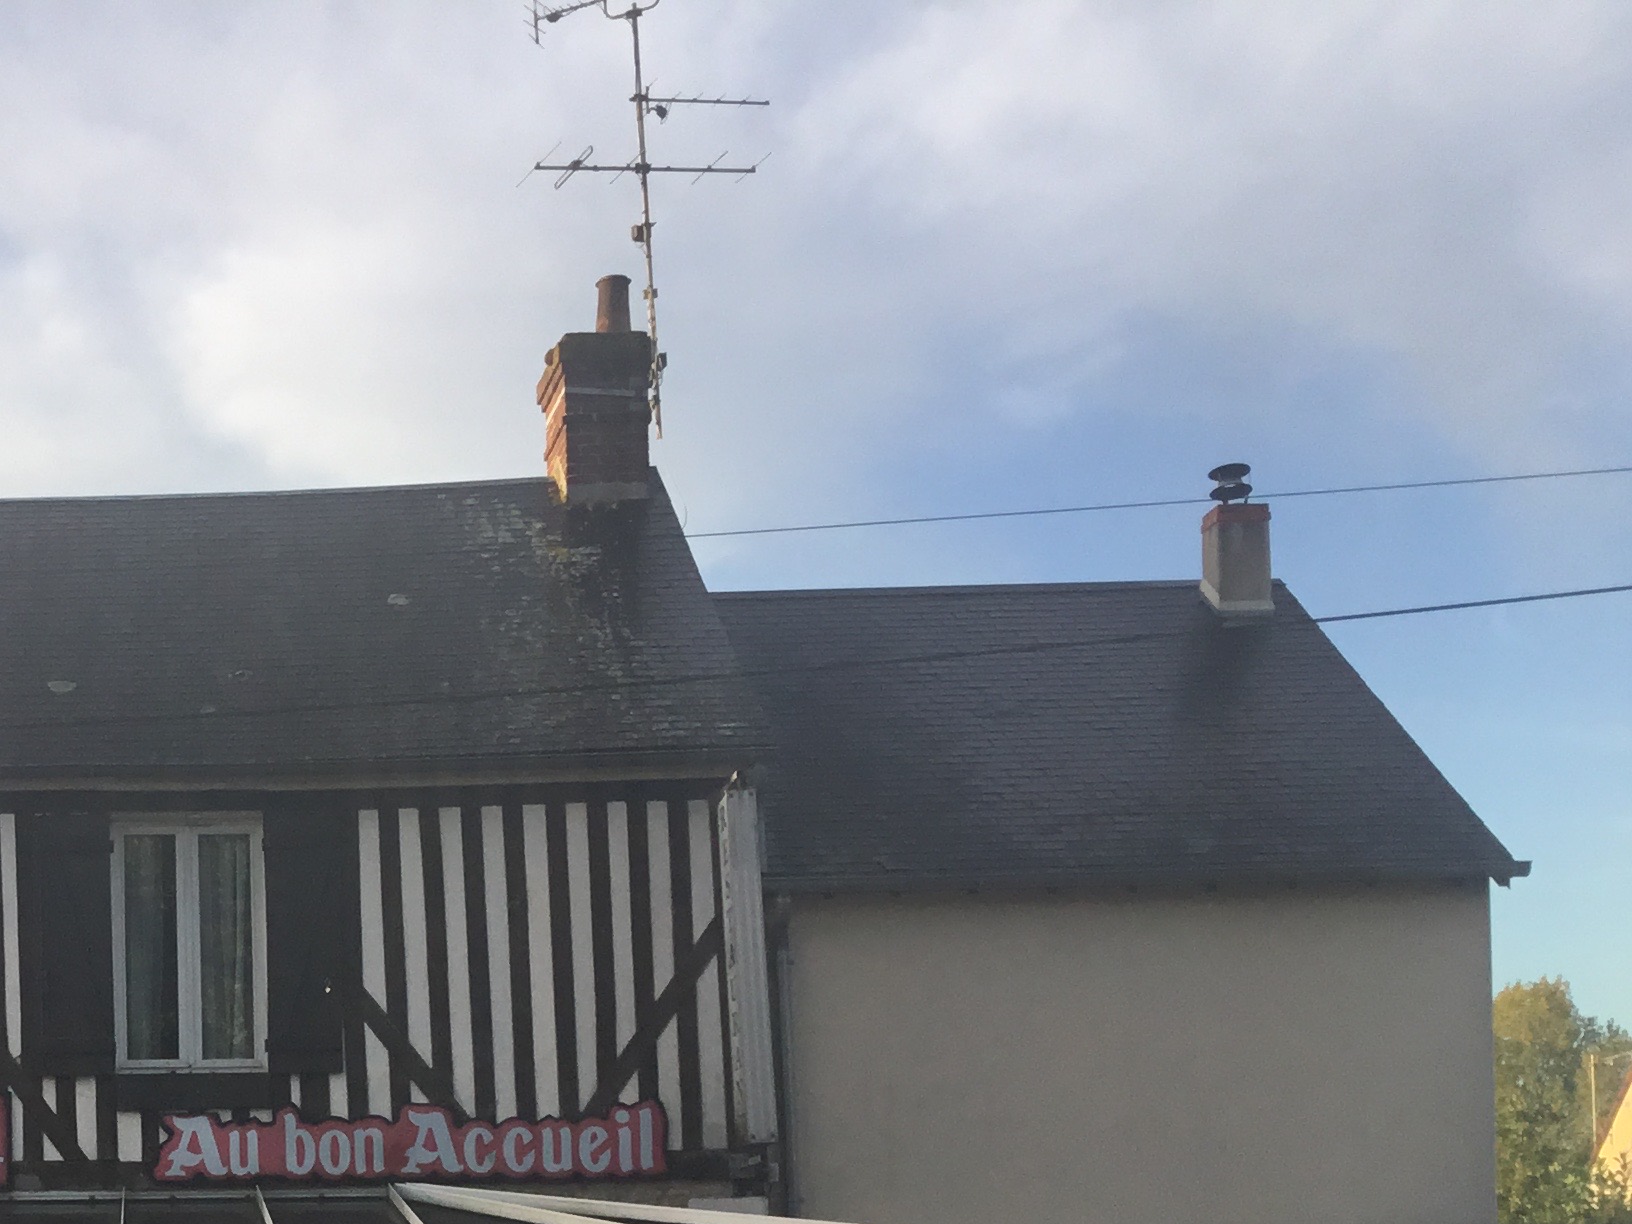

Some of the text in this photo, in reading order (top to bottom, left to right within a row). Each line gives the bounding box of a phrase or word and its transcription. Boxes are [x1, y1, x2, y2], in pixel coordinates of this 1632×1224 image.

[164, 1108, 654, 1177] Au bon Accueil
